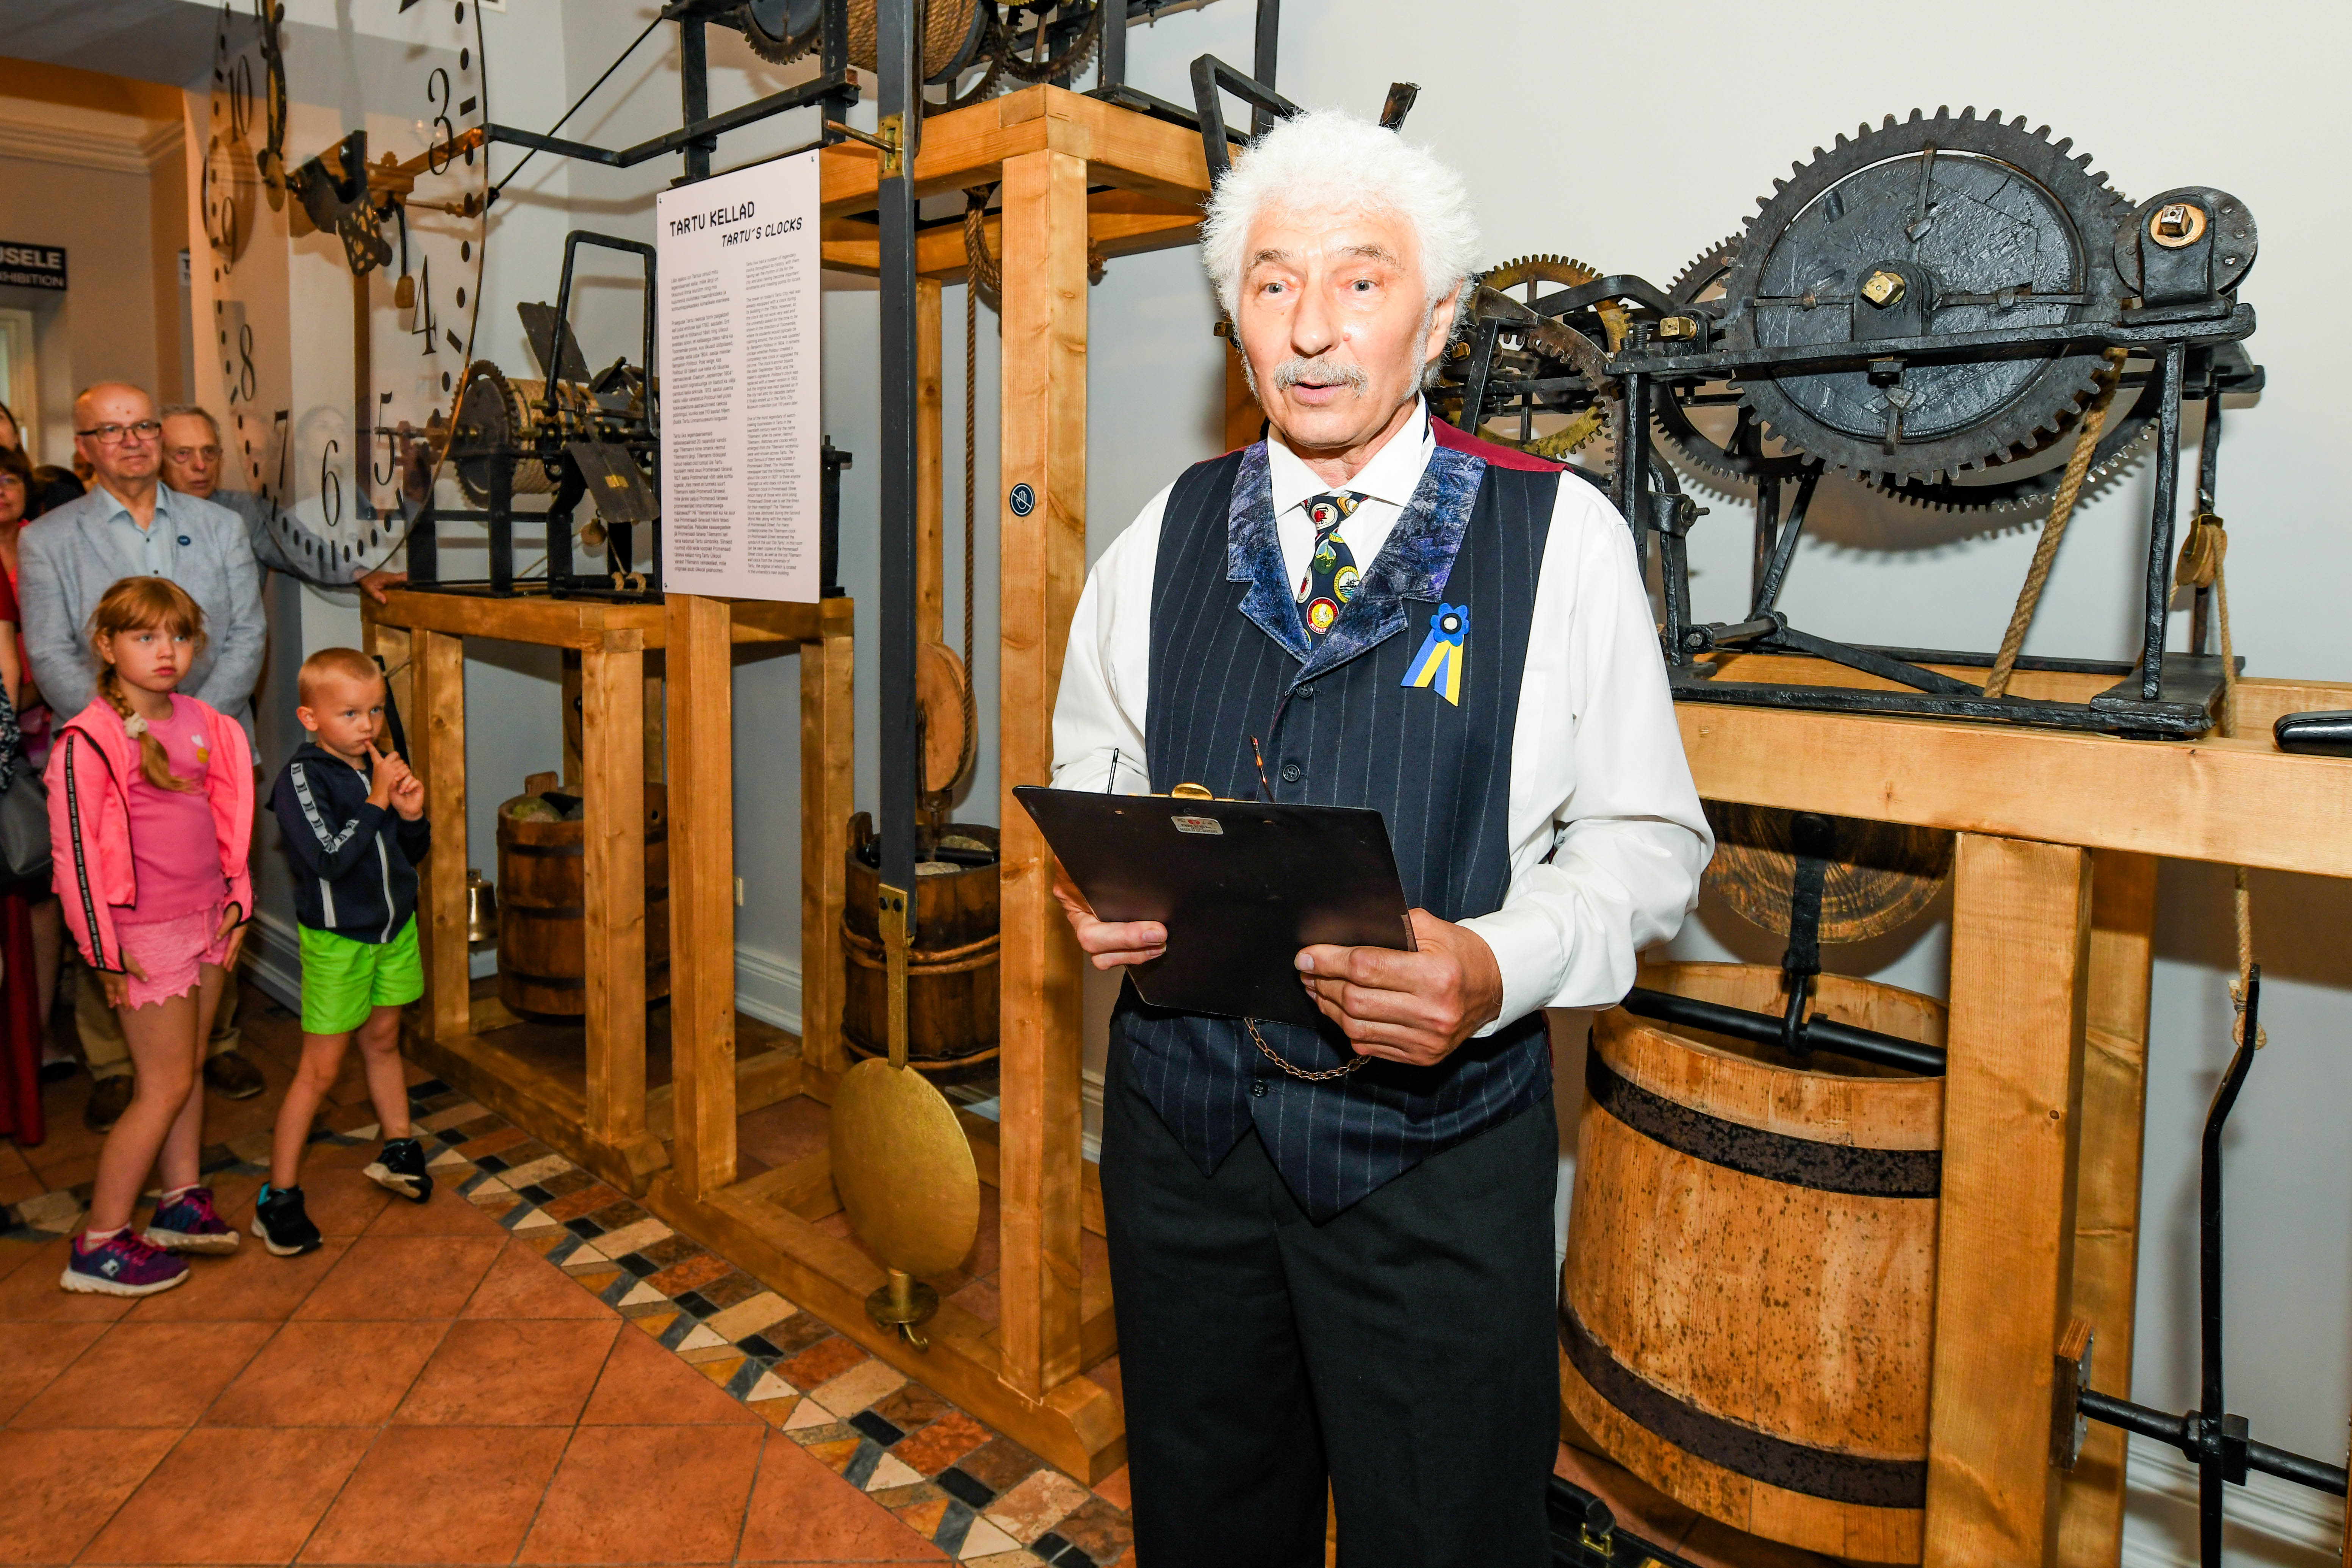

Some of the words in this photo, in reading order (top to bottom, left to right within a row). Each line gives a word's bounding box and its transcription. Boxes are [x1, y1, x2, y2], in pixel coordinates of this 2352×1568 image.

[427, 67, 453, 176] 3
[0, 246, 62, 269] SELE
[222, 197, 237, 274] 9
[670, 213, 705, 237] TARTU
[710, 201, 754, 227] KELLAD
[765, 217, 802, 236] CLOCKS
[412, 254, 437, 355] 4
[239, 324, 255, 402] 8
[274, 410, 289, 489] 7
[374, 391, 395, 486] 5
[321, 440, 340, 527] 6
